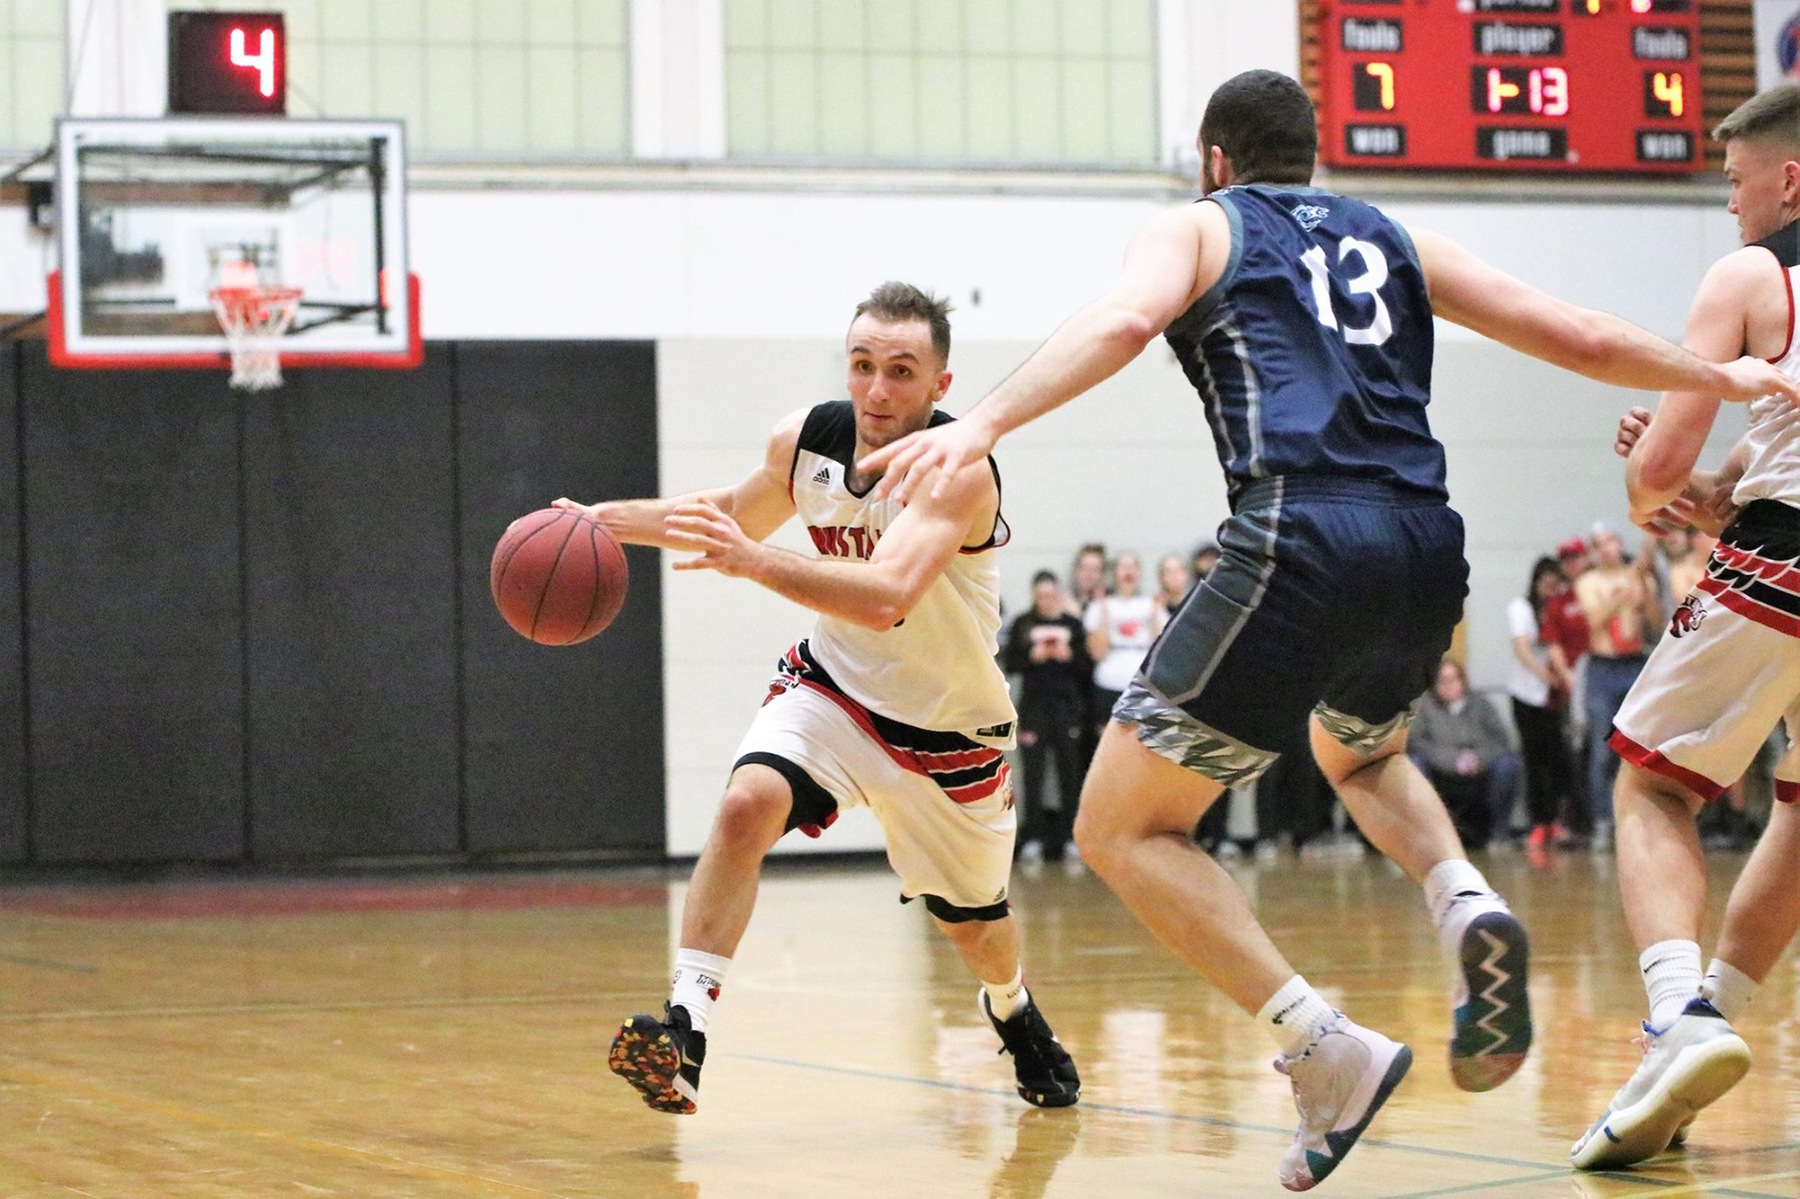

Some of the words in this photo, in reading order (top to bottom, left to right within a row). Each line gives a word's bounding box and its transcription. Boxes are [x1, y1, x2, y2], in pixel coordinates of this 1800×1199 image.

[229, 27, 275, 97] 4
[1366, 62, 1395, 110] 7
[1653, 72, 1683, 116] 4
[1300, 235, 1393, 346] 13
